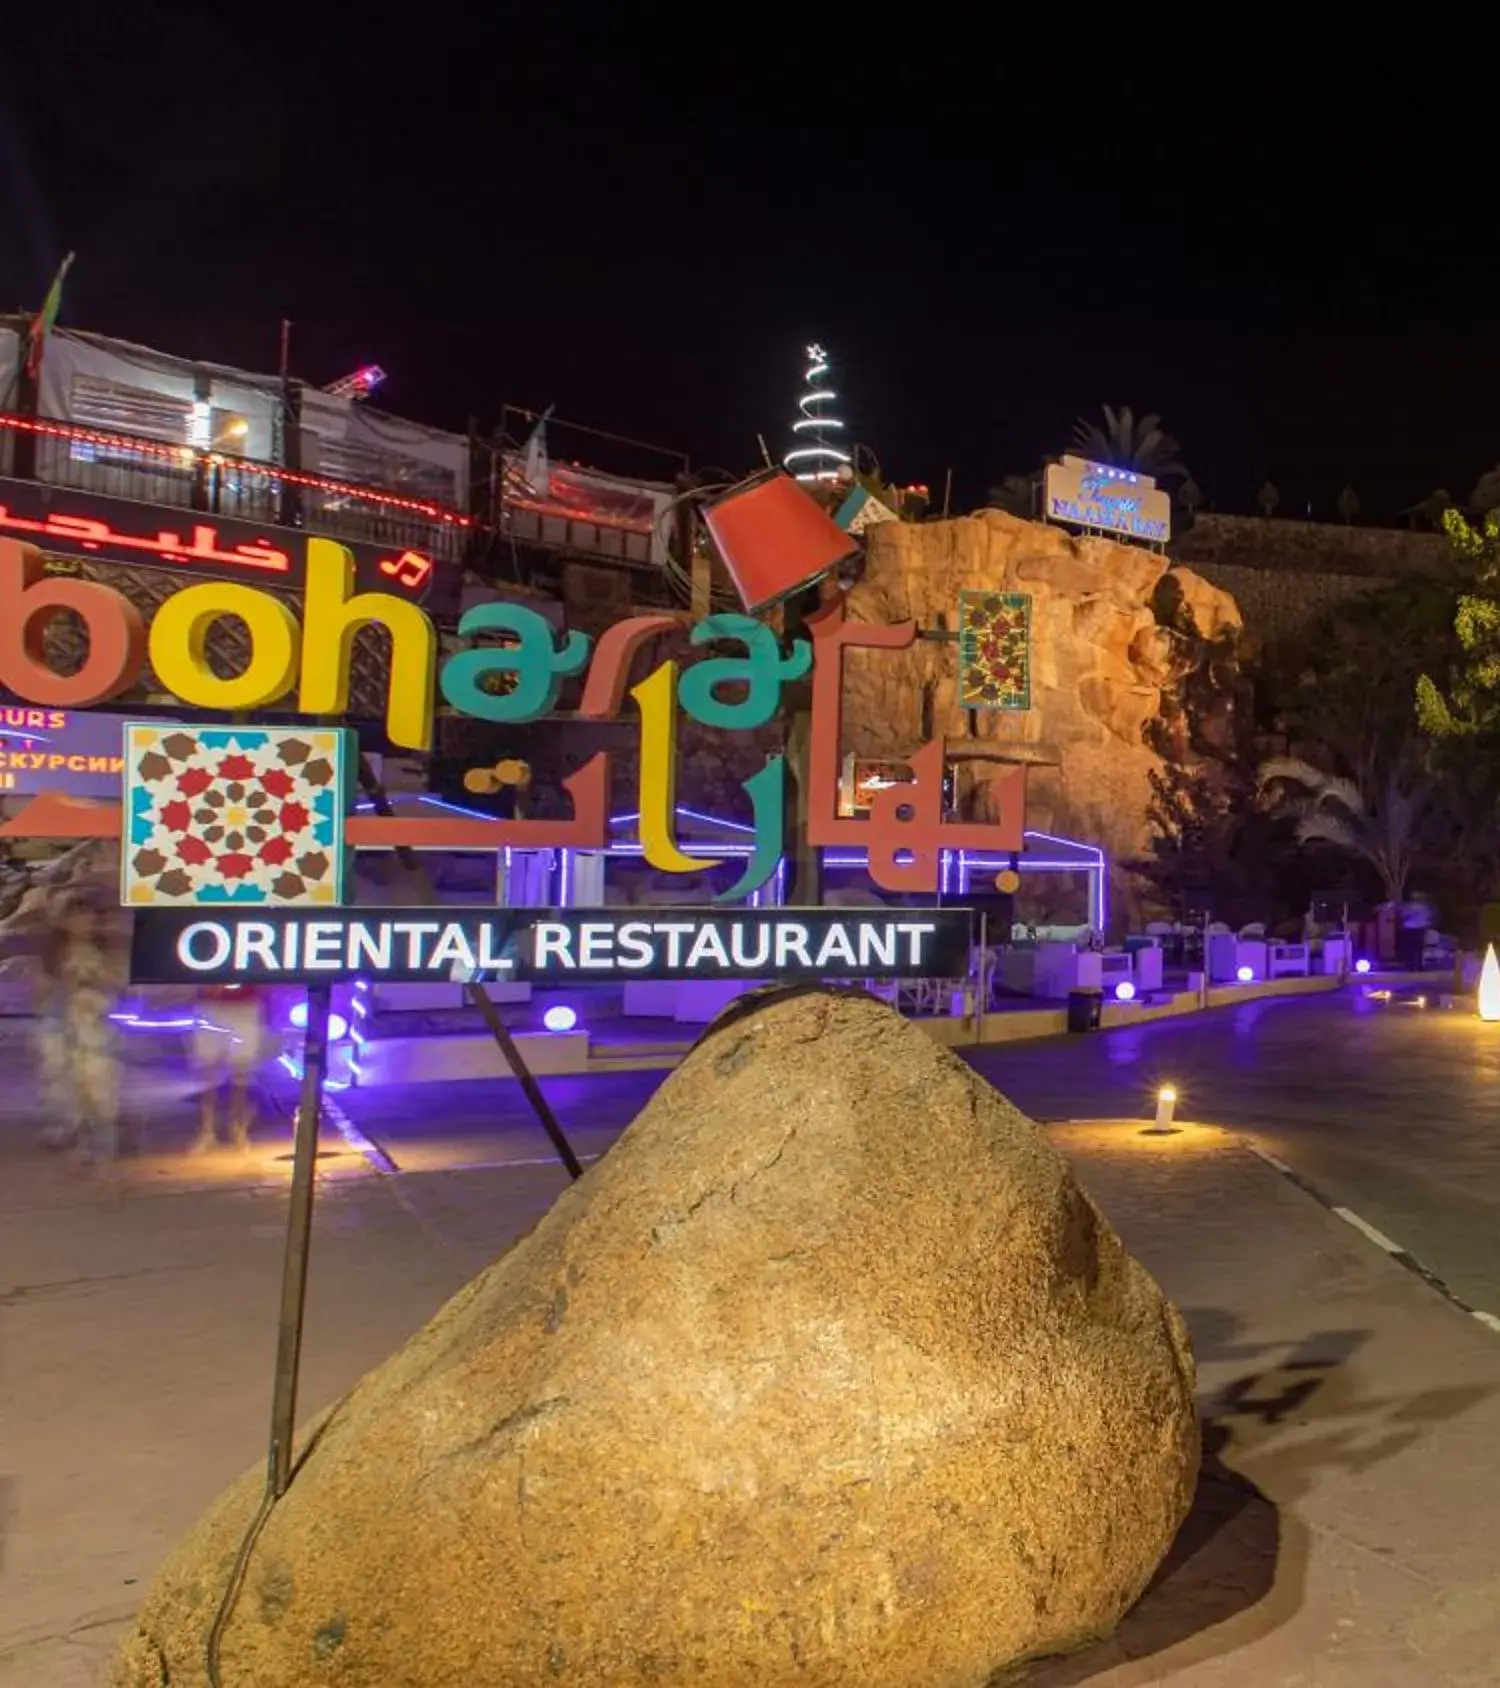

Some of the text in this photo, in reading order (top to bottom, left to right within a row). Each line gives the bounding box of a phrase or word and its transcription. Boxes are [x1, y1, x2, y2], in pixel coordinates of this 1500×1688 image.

[0, 708, 66, 729] URS
[178, 921, 935, 970] ORIENTAL RESTAURANT
